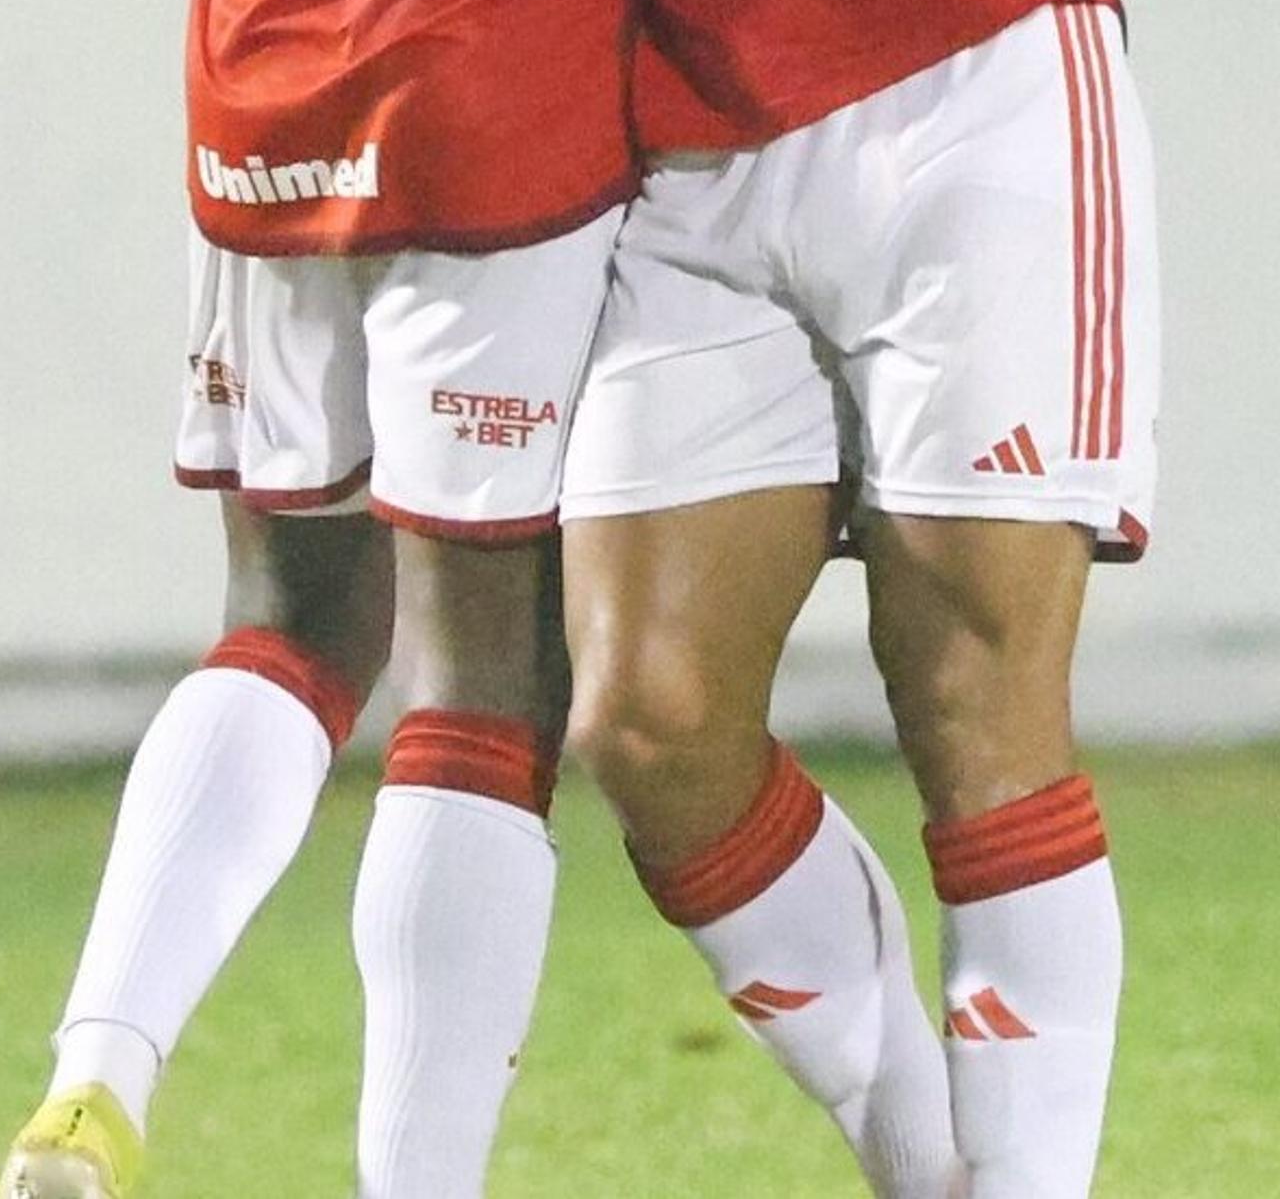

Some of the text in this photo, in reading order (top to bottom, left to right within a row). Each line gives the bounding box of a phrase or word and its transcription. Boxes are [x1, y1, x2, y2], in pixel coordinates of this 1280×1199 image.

[195, 142, 379, 205] Unimed
[431, 389, 557, 426] ESTRELA
[477, 421, 535, 449] BET
